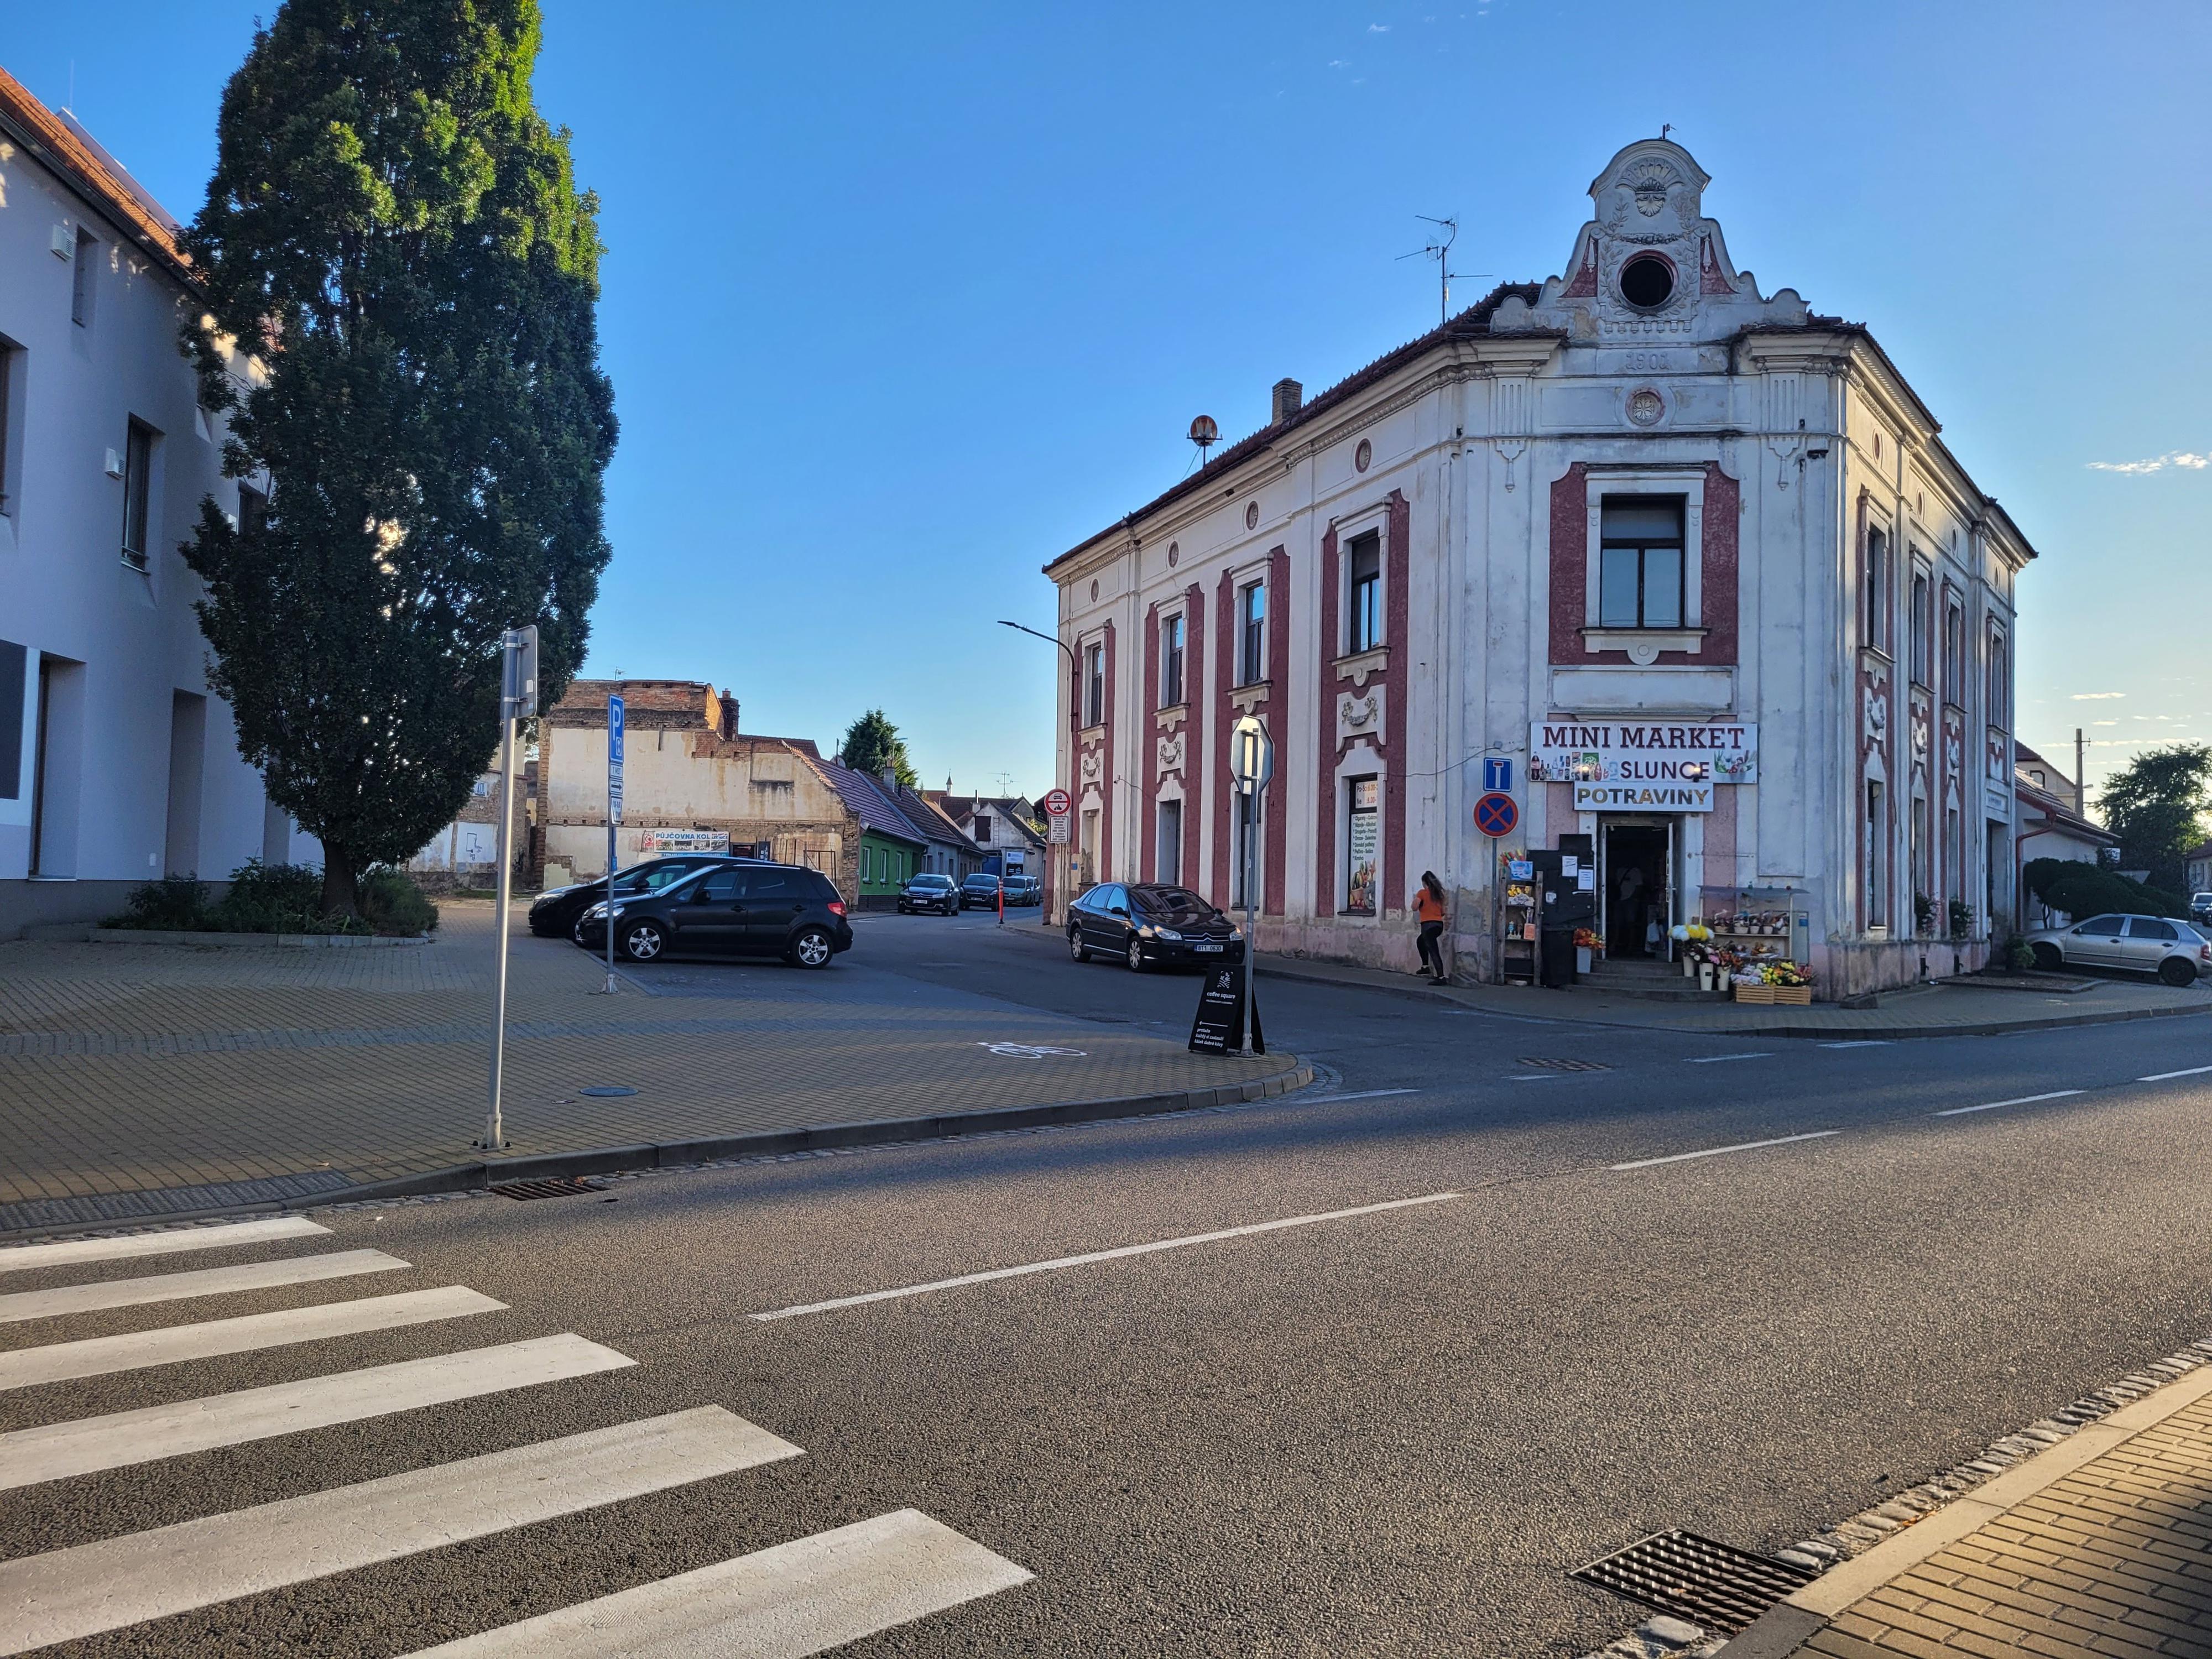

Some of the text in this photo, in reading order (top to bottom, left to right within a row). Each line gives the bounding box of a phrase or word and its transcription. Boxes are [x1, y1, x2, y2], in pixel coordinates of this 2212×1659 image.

[613, 705, 621, 740] P
[1542, 726, 1745, 749] MINI MARKET
[1620, 761, 1710, 780] SLUNCE
[1577, 787, 1709, 805] POTRAVINY
